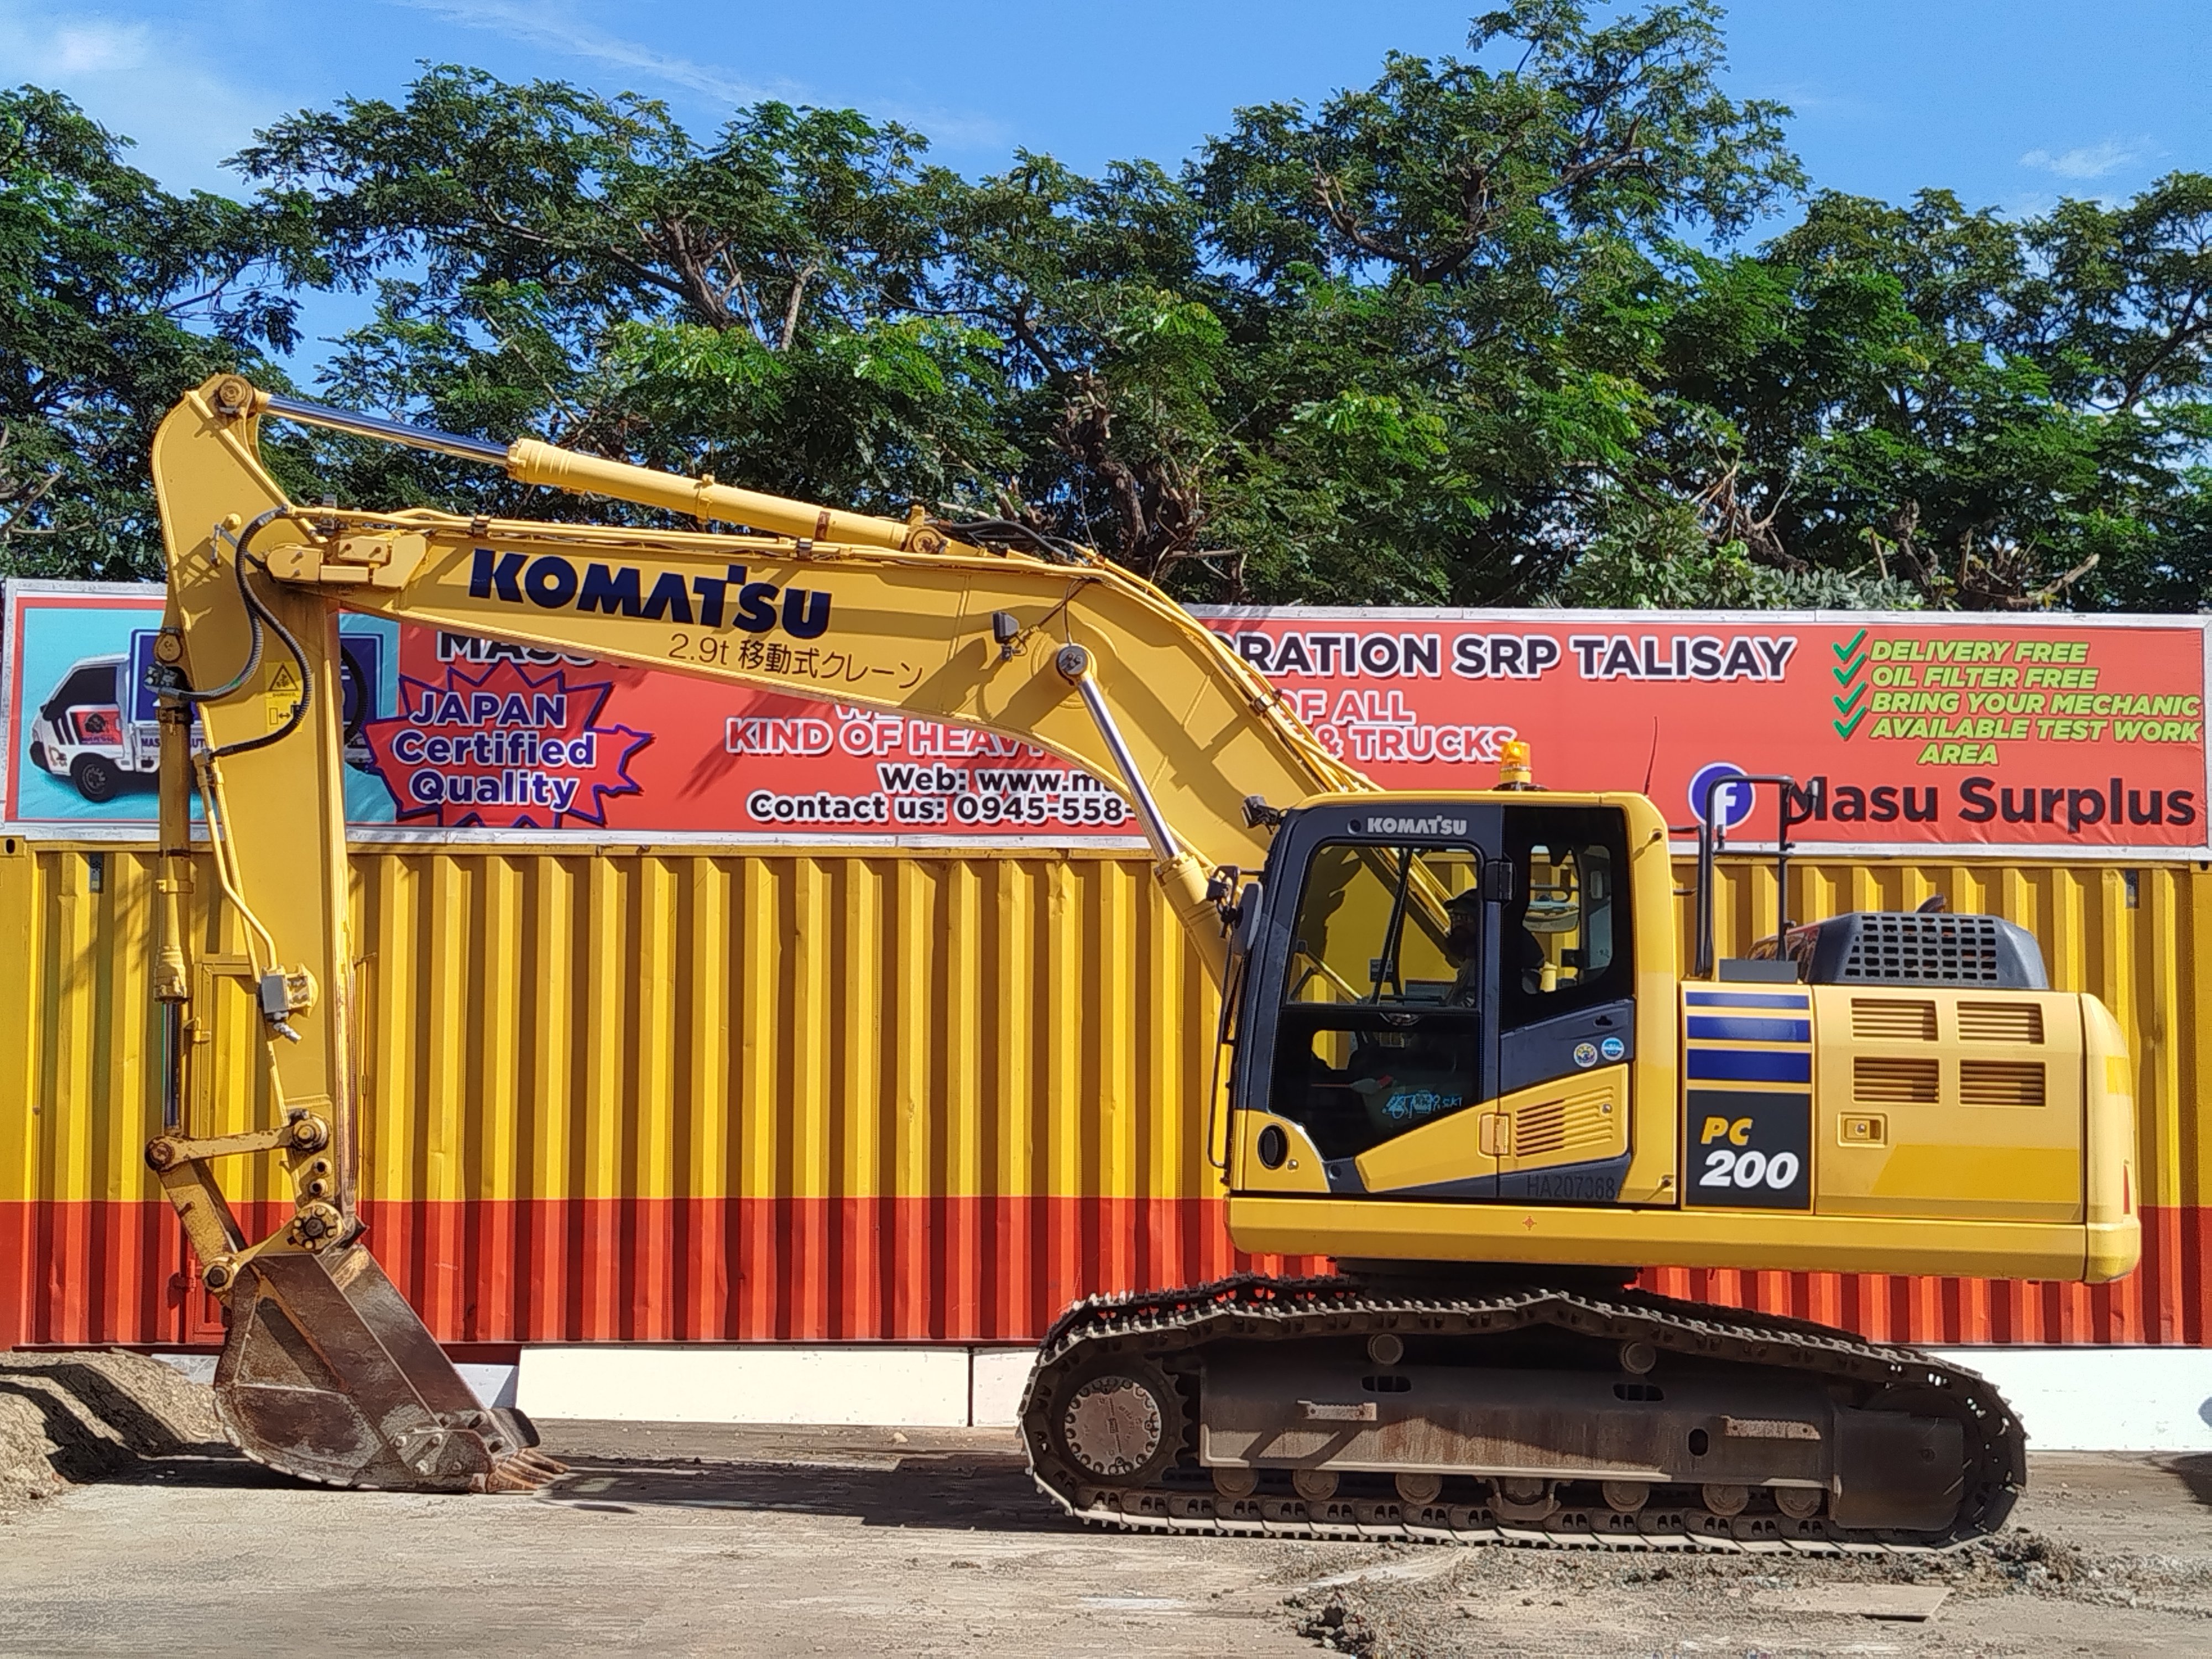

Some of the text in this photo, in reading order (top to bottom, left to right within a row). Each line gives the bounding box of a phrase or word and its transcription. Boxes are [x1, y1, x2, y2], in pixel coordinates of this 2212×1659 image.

[468, 548, 832, 640] KOMATSU
[669, 634, 923, 688] 2.9t 移動式クレーン
[1214, 632, 1797, 681] RATION SRP TALISAY
[1870, 640, 2089, 664] DELIVERY FREE
[1871, 666, 2099, 690] OIL FILTER FREE
[409, 692, 567, 728] JAPAN
[1333, 690, 1416, 726] ALL
[1871, 691, 2201, 717] BRING YOUR MECHANIC
[726, 717, 833, 755] KIND
[839, 719, 904, 756] OF
[1349, 726, 1517, 763] TRUCKS
[1870, 717, 2202, 742] AVAILABLE TEST WORK
[393, 729, 597, 768] Certified
[1917, 743, 1999, 765] AREA
[409, 768, 580, 812] Quality
[878, 763, 1116, 794] Web: www.m
[747, 790, 888, 822] Contact
[895, 796, 946, 822] us:
[1782, 776, 2196, 834] Masu Surplus
[1367, 815, 1467, 835] KOMATSU
[1700, 1116, 1754, 1146] PC
[1699, 1150, 1799, 1189] 200
